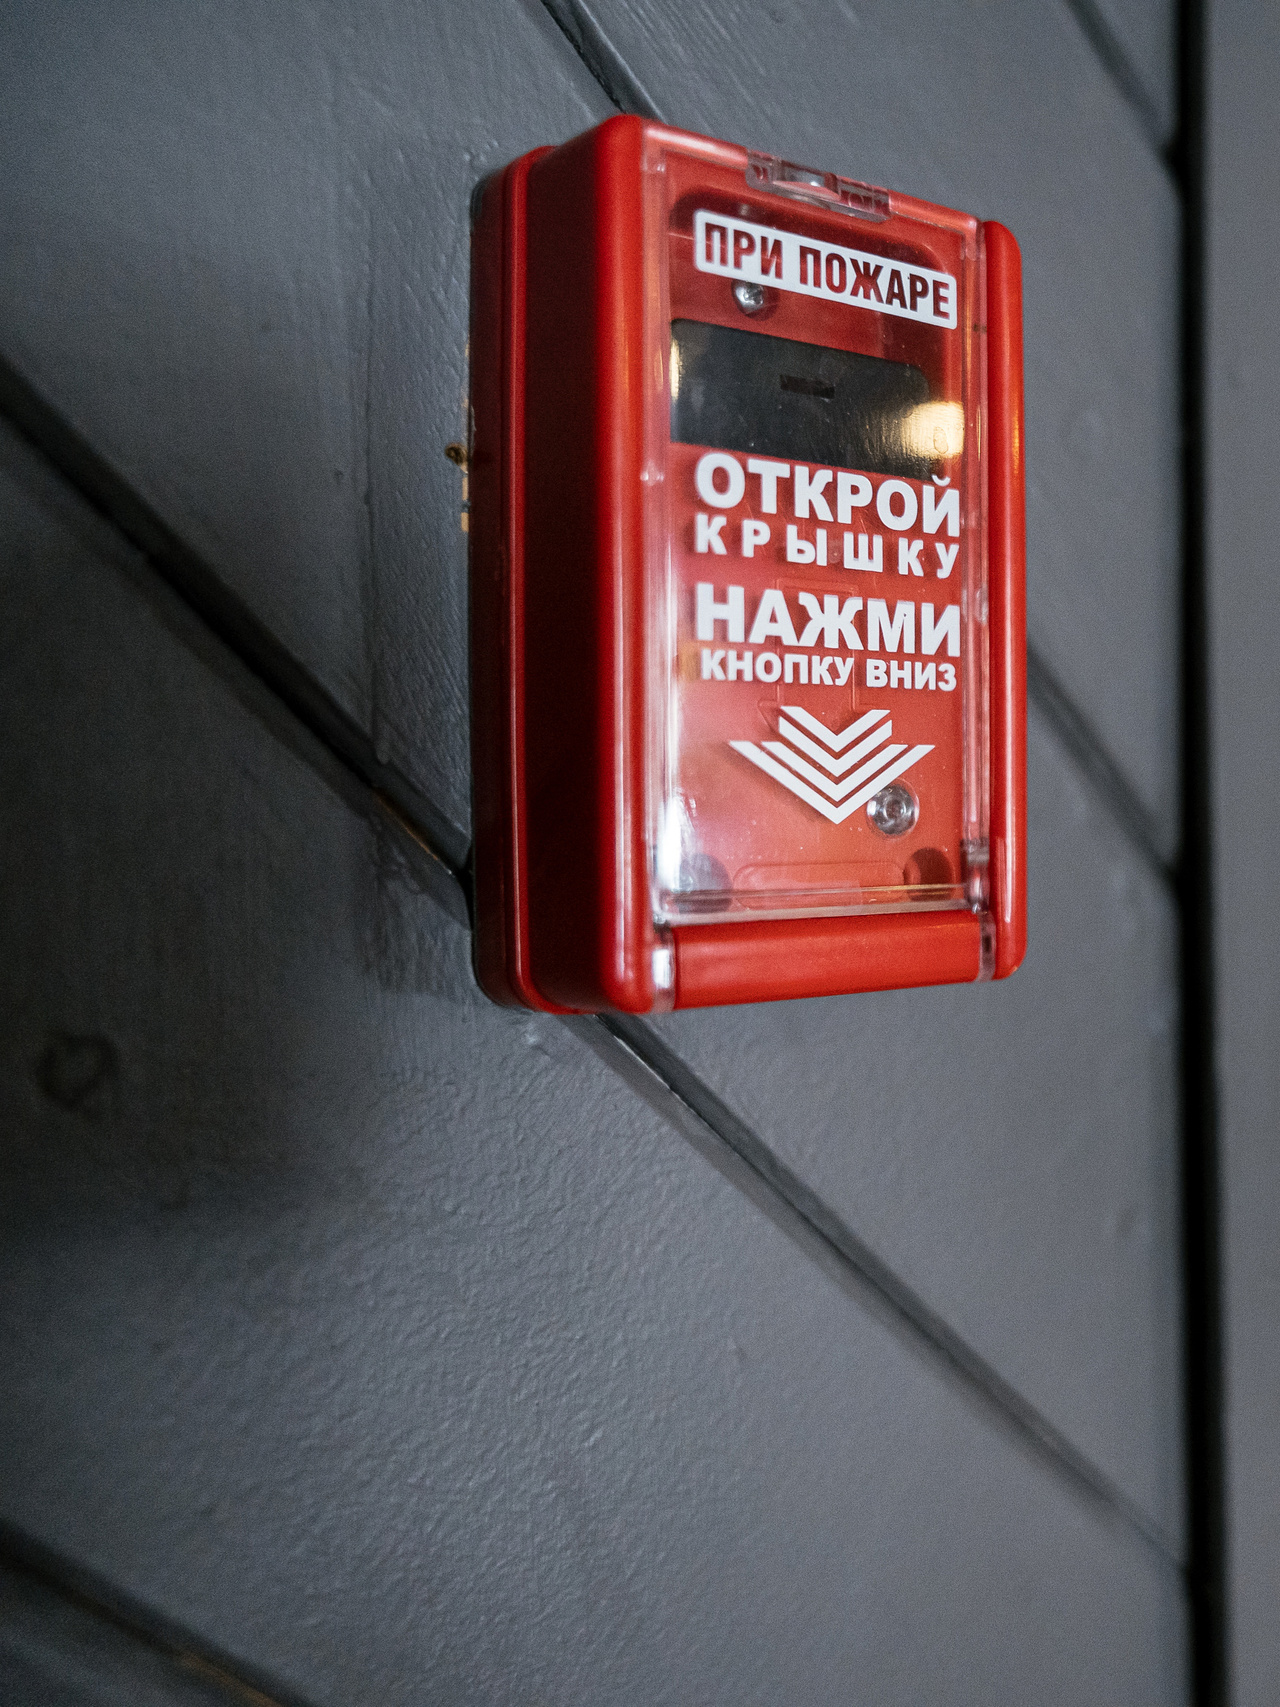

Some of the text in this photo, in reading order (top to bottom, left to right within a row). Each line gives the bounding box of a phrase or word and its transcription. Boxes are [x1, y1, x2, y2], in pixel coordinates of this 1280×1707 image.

[703, 220, 951, 320] ПРИ ПОЖАРЕ
[695, 453, 960, 537] ОТКРОЙ
[695, 512, 959, 579] КРЫШКУ
[695, 582, 961, 658] НАЖМИ
[700, 647, 958, 692] КНОПКУ ВНИЗ
